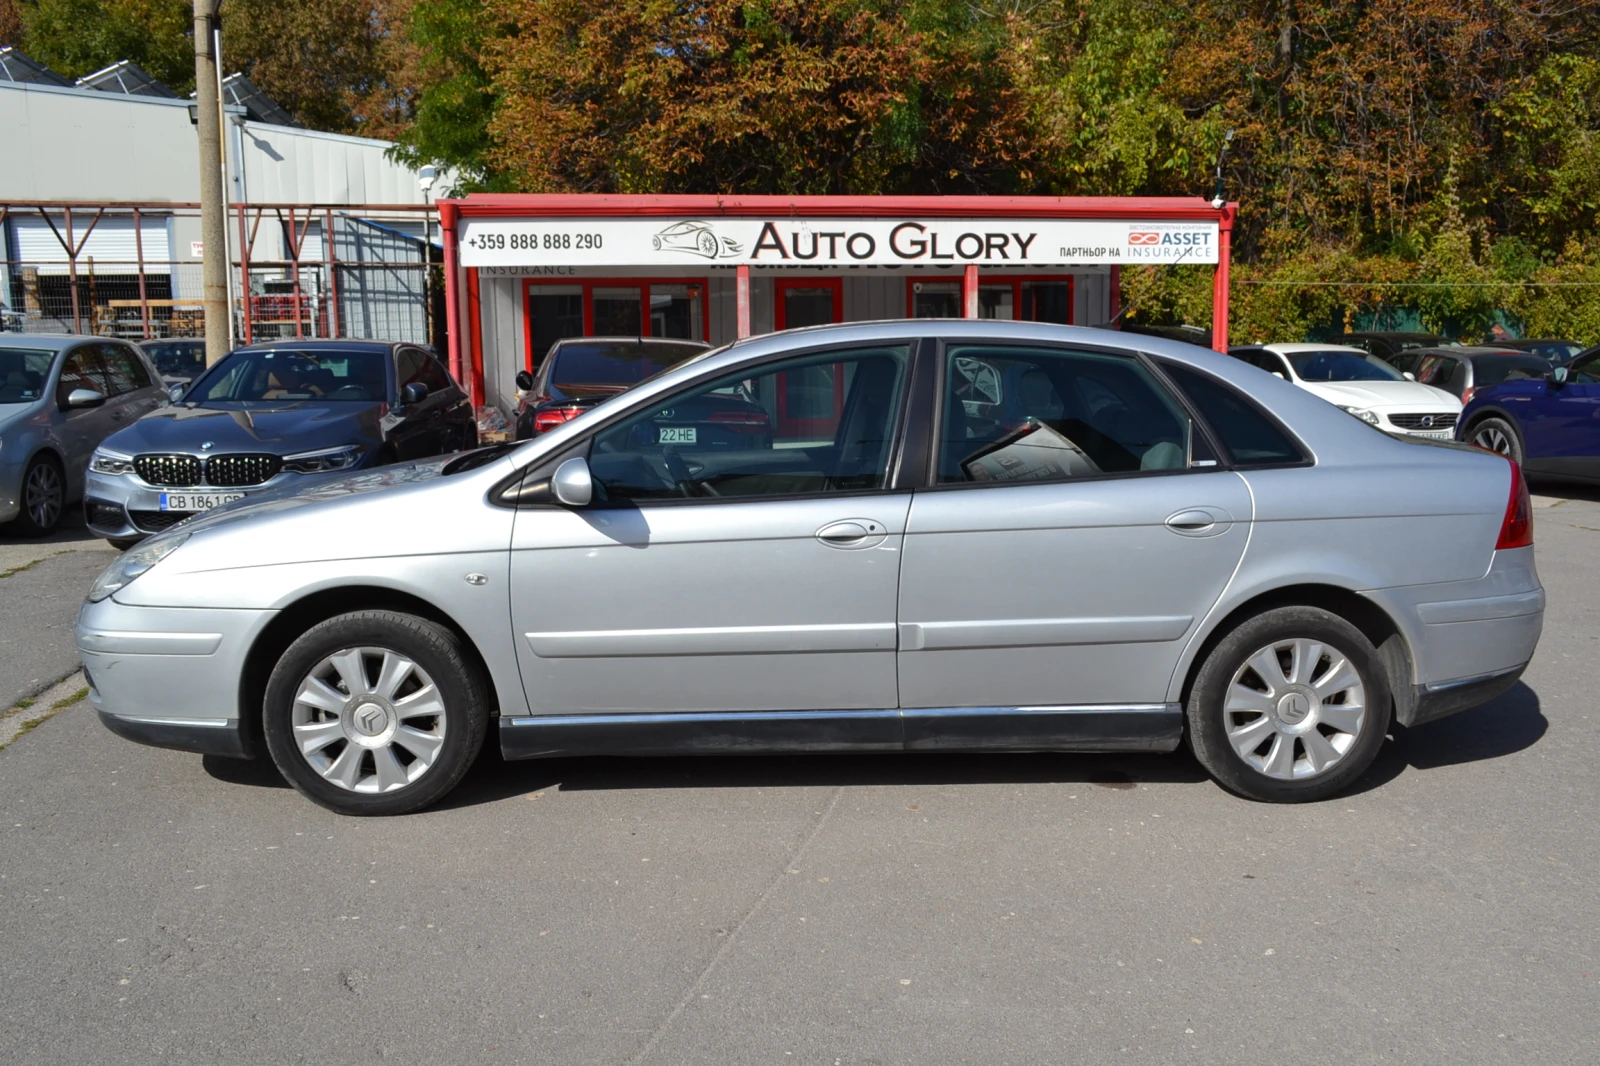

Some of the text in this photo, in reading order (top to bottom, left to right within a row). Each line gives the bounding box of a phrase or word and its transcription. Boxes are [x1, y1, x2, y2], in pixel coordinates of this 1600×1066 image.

[468, 233, 603, 250] +359 888 888 290
[750, 221, 1038, 261] AUTO GLORY
[1161, 232, 1211, 245] ASSET
[1059, 247, 1121, 257] ПАРТНЬОР НА
[1127, 247, 1212, 257] INSURANCE
[678, 429, 694, 441] HE
[169, 495, 186, 509] CB
[190, 495, 220, 509] 1861
